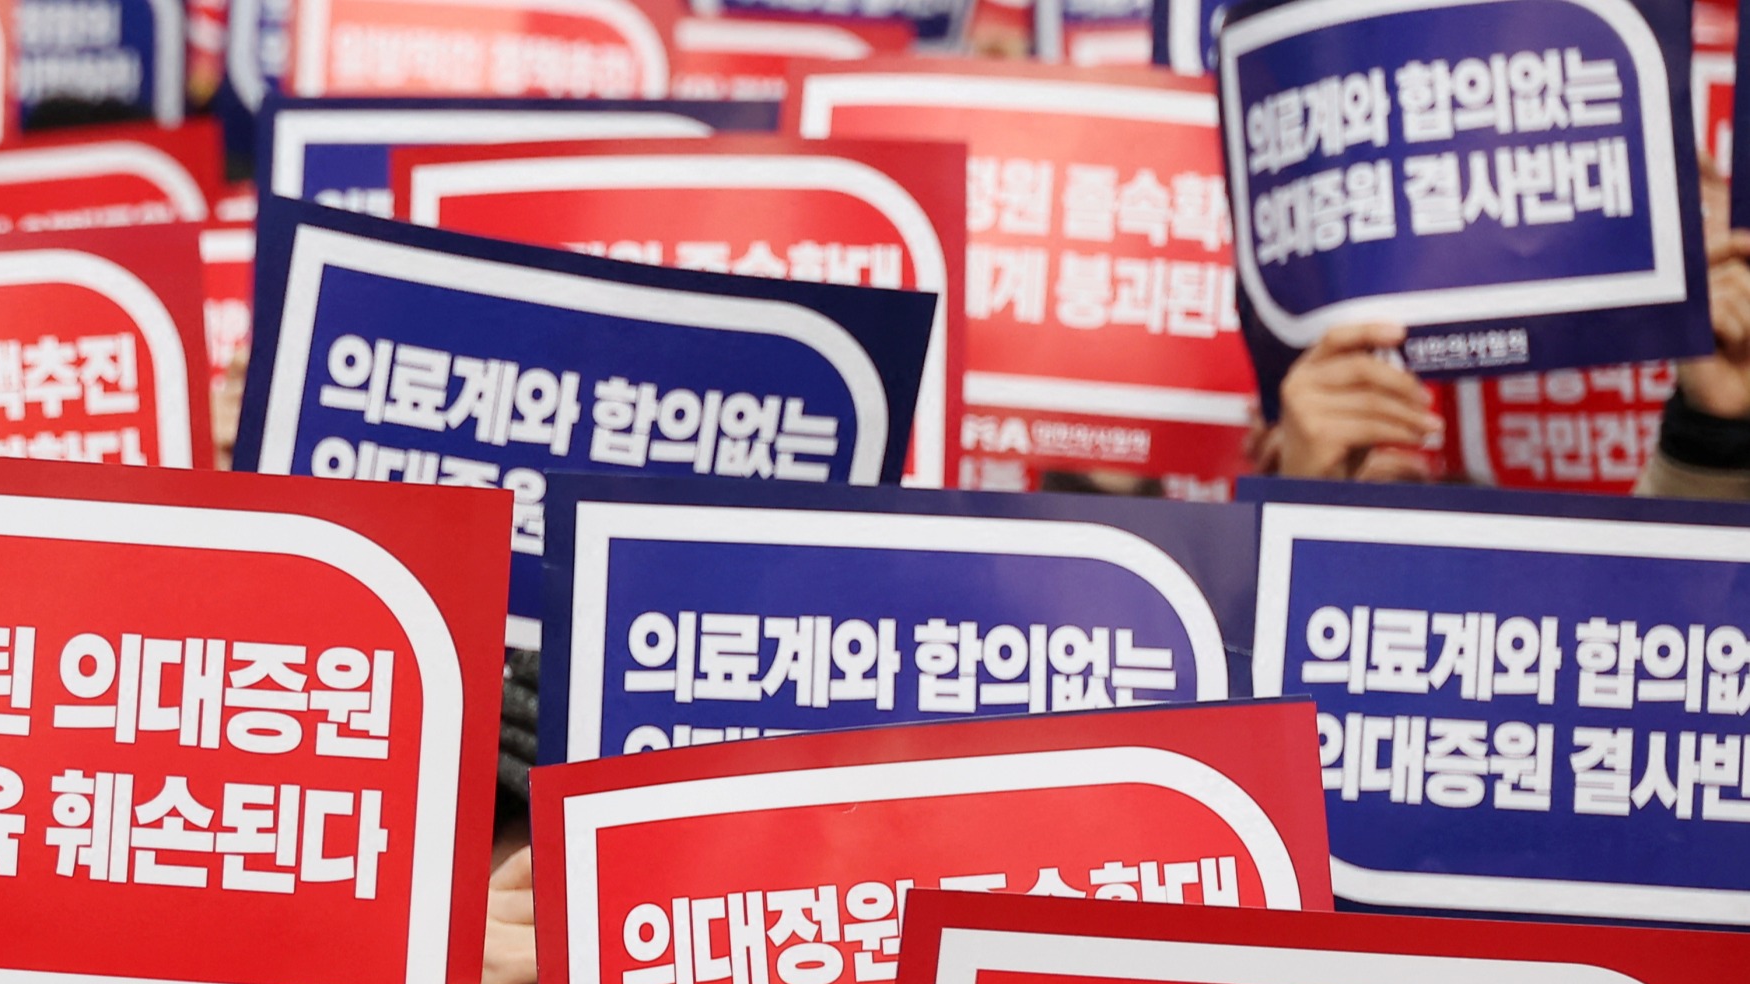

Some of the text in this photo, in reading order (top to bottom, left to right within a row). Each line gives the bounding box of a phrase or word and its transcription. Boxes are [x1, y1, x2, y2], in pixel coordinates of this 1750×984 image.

[1247, 47, 1622, 174] 의료계와 합의없는
[1061, 163, 1234, 251] 졸속확
[1254, 136, 1632, 265] 의대증원 결사반대
[319, 334, 579, 456] 의료계와
[589, 377, 840, 484] 합의없는
[52, 632, 396, 761] 의대증원
[623, 610, 1177, 714] 의료계와 합의없는
[1301, 605, 1563, 705] 의료계와
[1316, 711, 1555, 812] 의대증원
[45, 767, 389, 901] 훼손된다
